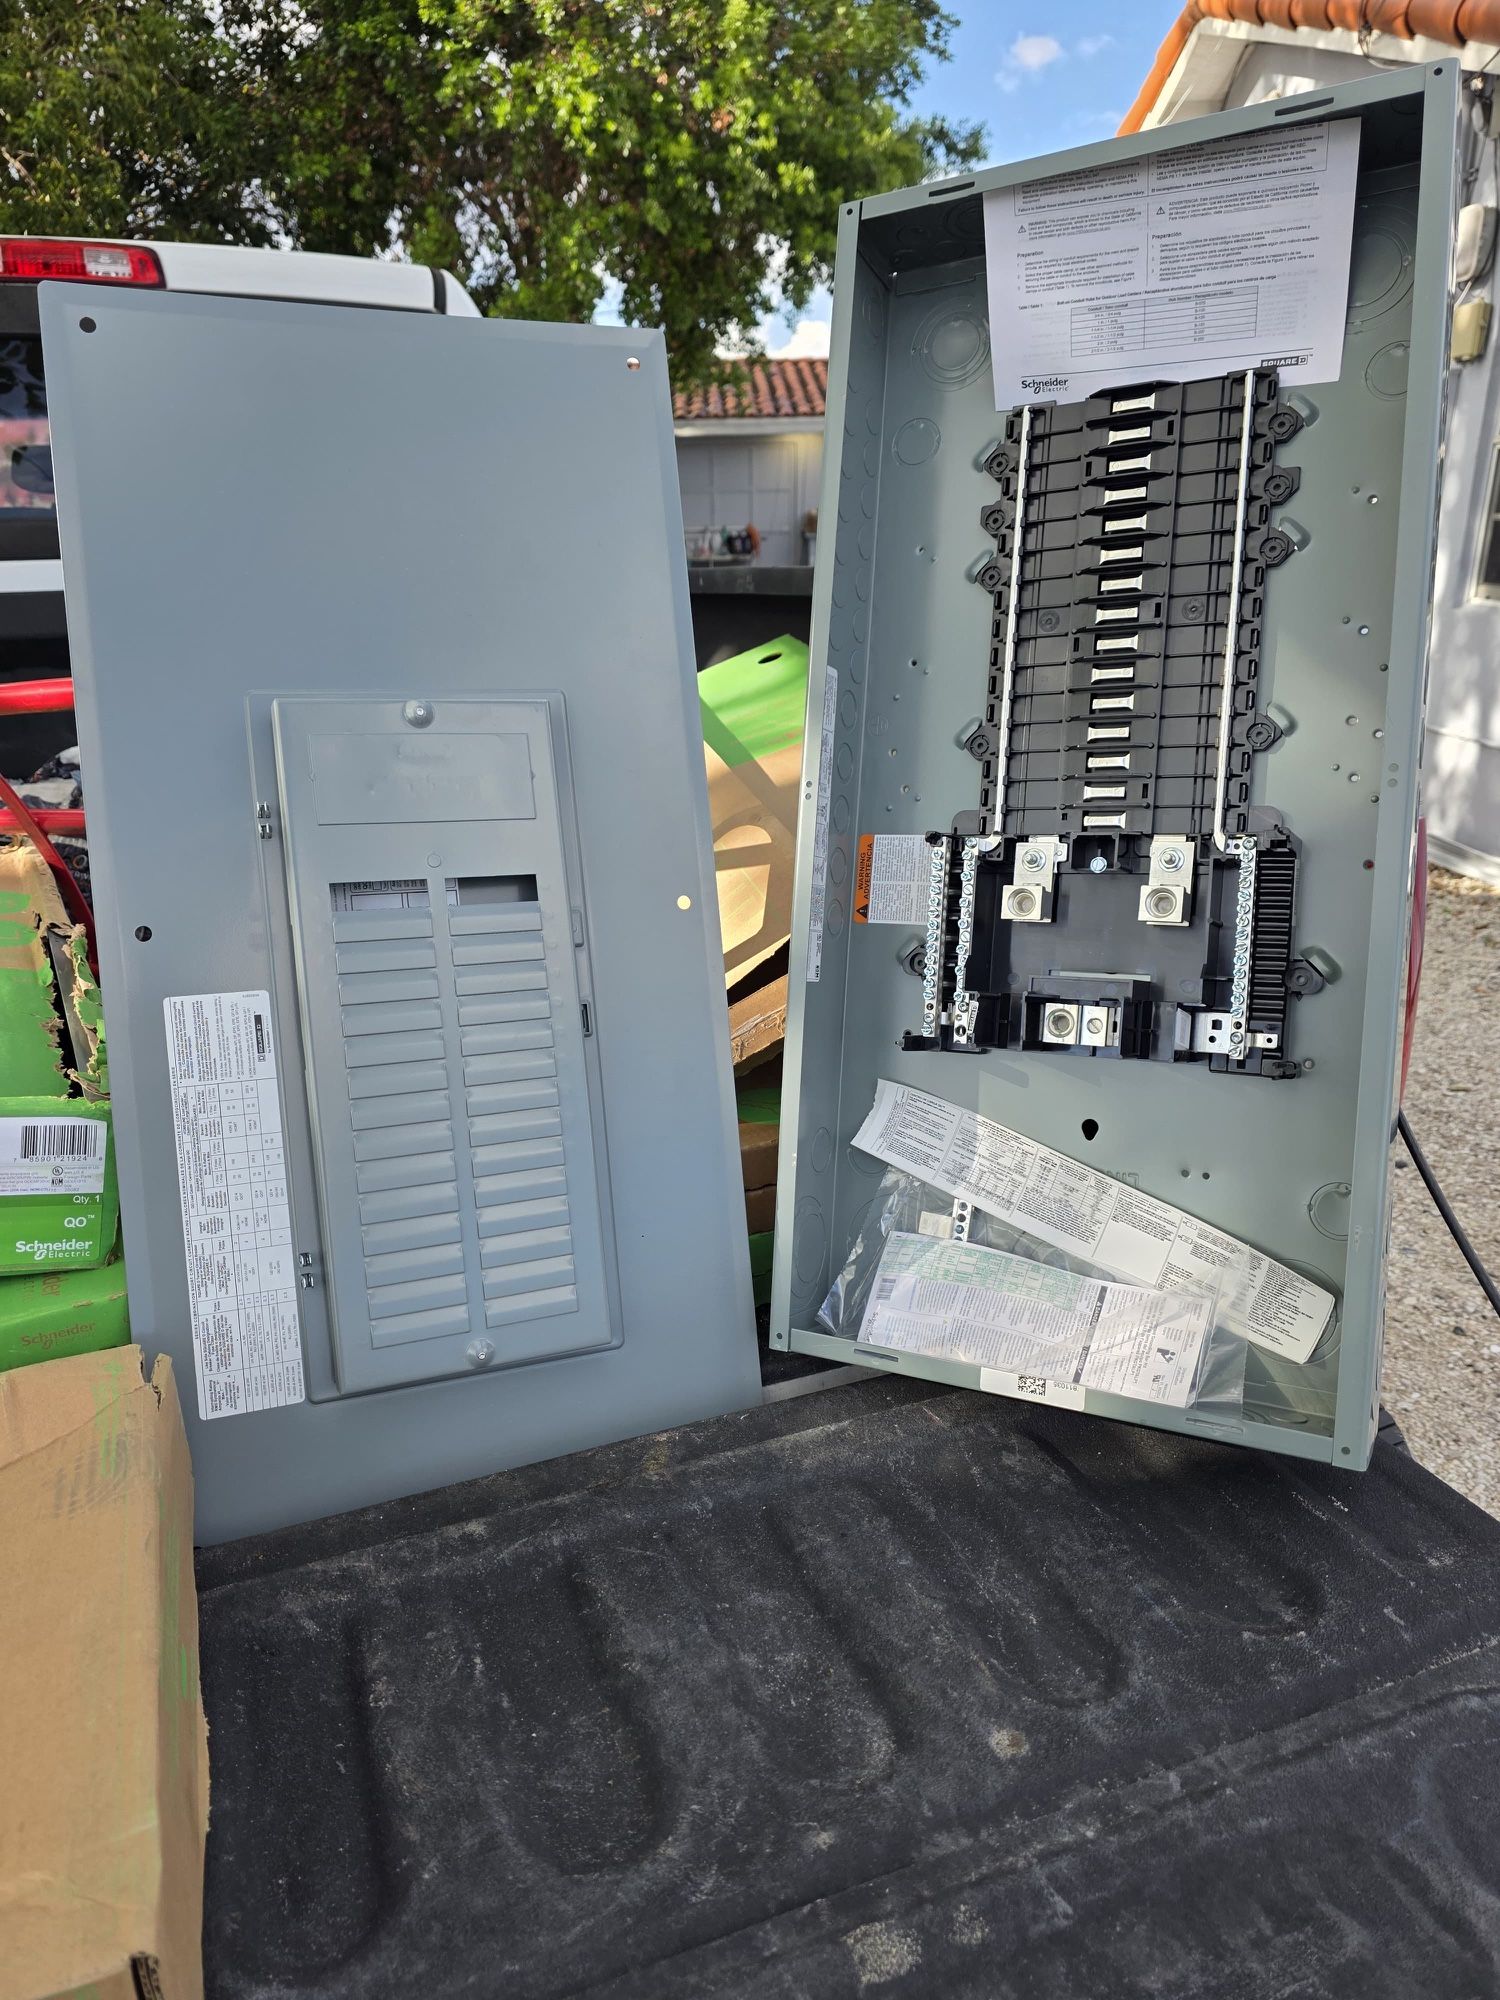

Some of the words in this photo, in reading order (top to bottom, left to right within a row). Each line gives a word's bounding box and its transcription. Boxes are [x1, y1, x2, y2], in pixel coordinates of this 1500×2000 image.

[1016, 250, 1043, 258] Preparation
[1021, 376, 1068, 388] Schneider
[857, 852, 865, 889] WARNING
[864, 842, 872, 899] ADVERTENCIA
[15, 1238, 92, 1252] Schneider
[21, 1322, 96, 1348] Schneider
